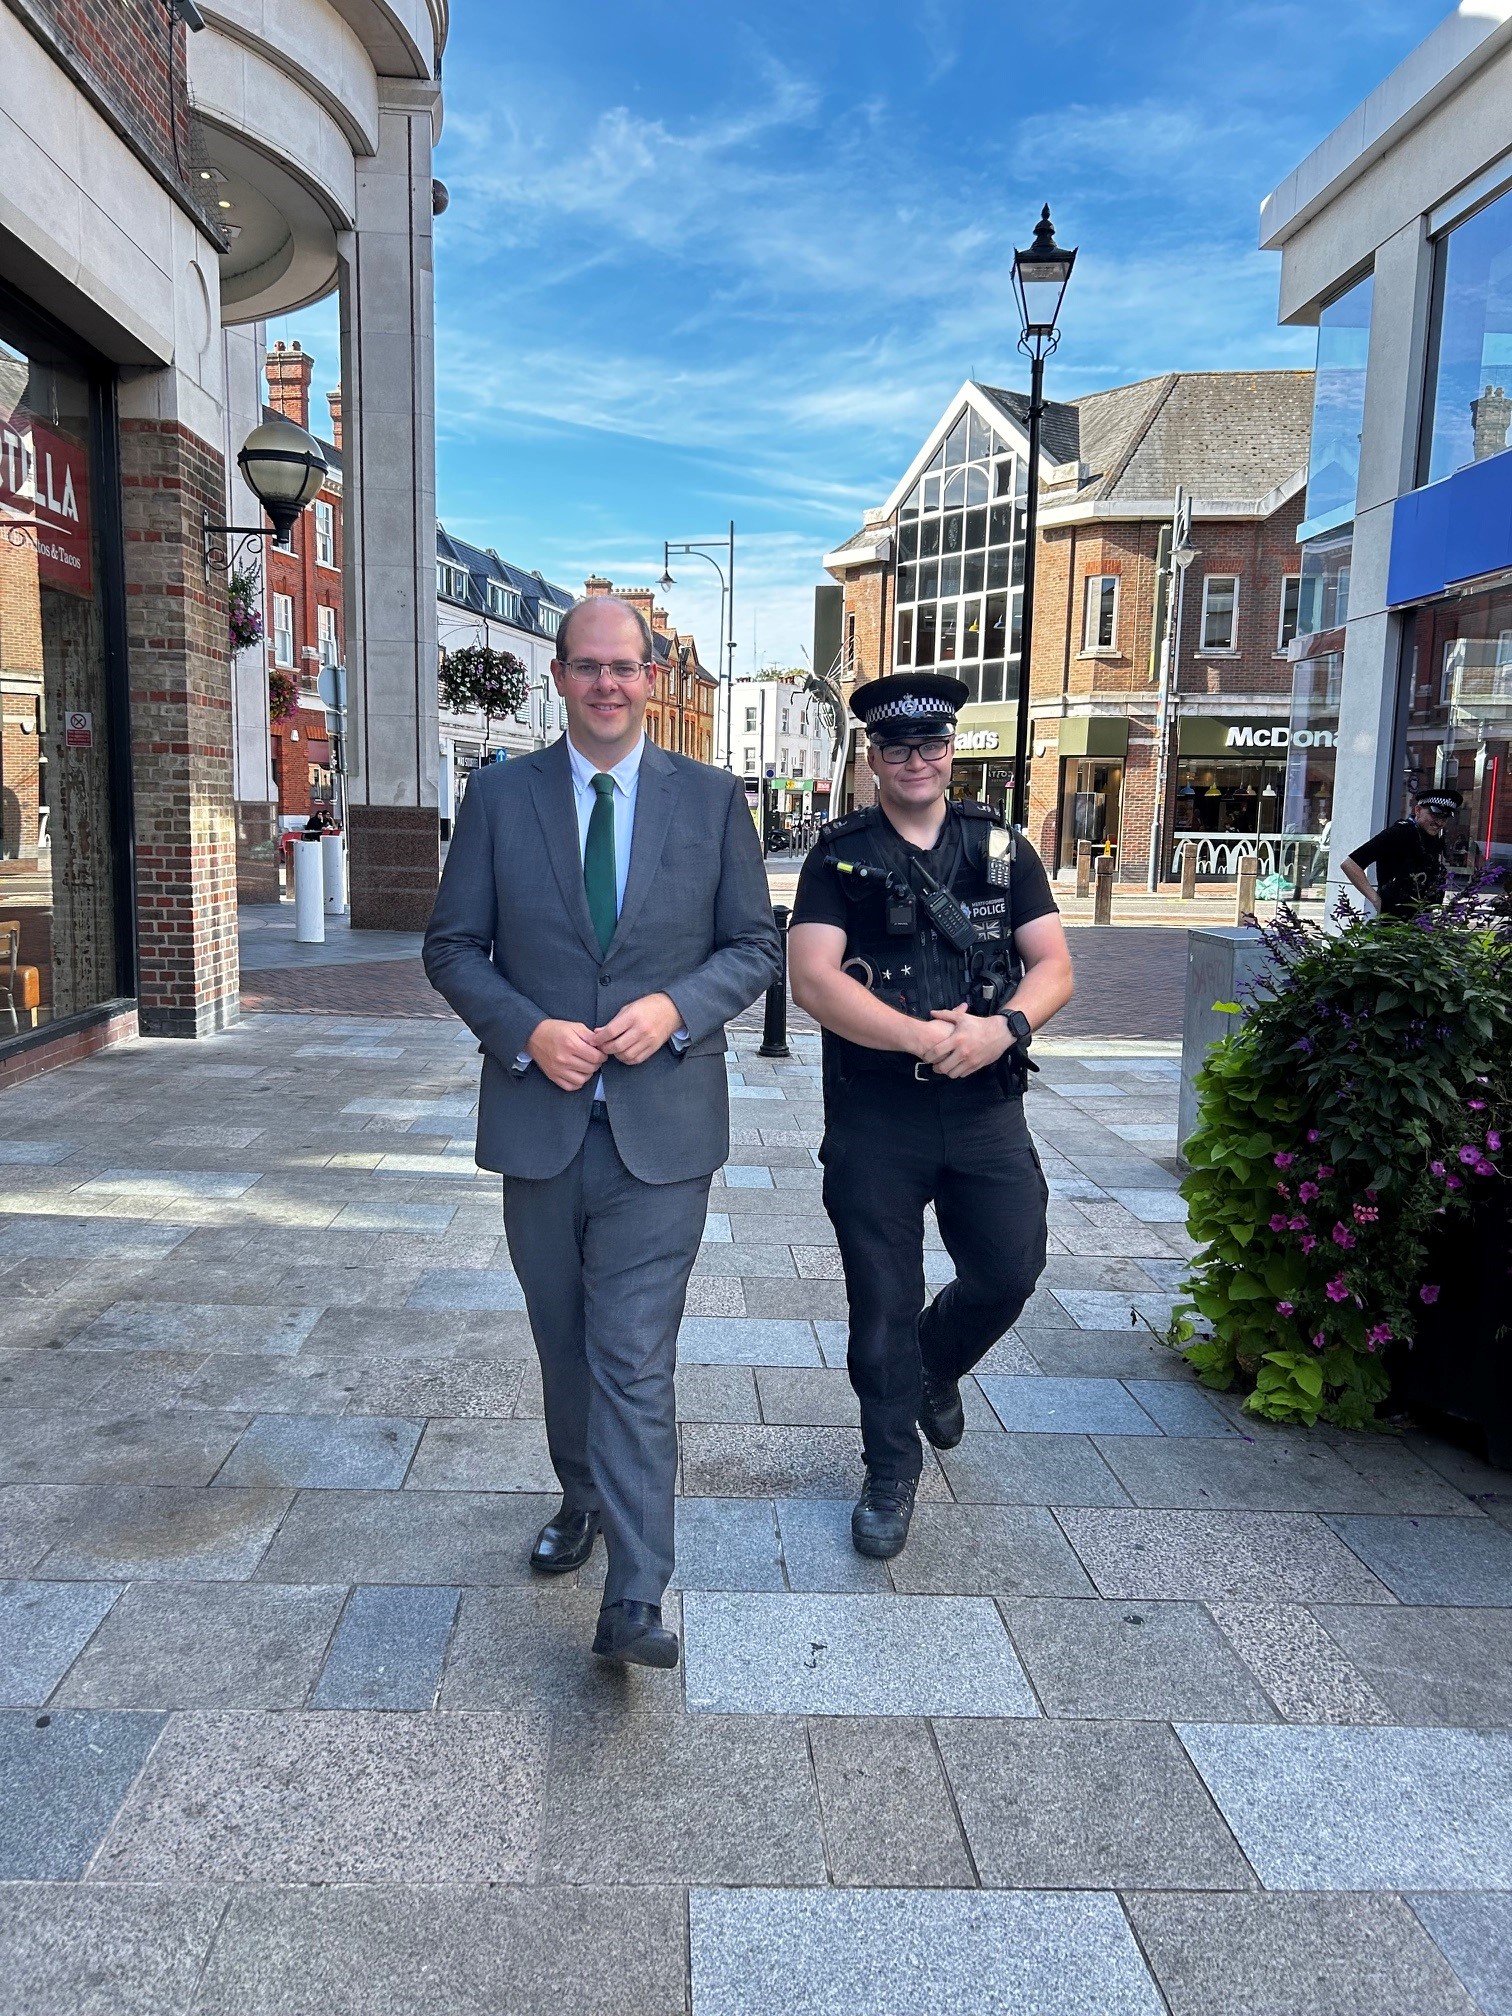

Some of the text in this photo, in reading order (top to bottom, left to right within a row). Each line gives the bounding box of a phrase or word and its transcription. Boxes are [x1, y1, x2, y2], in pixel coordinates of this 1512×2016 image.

[0, 429, 79, 523] TILLA
[51, 544, 58, 560] &
[59, 547, 81, 570] Tacos
[955, 730, 999, 749] ald's
[972, 902, 1006, 918] POLICE
